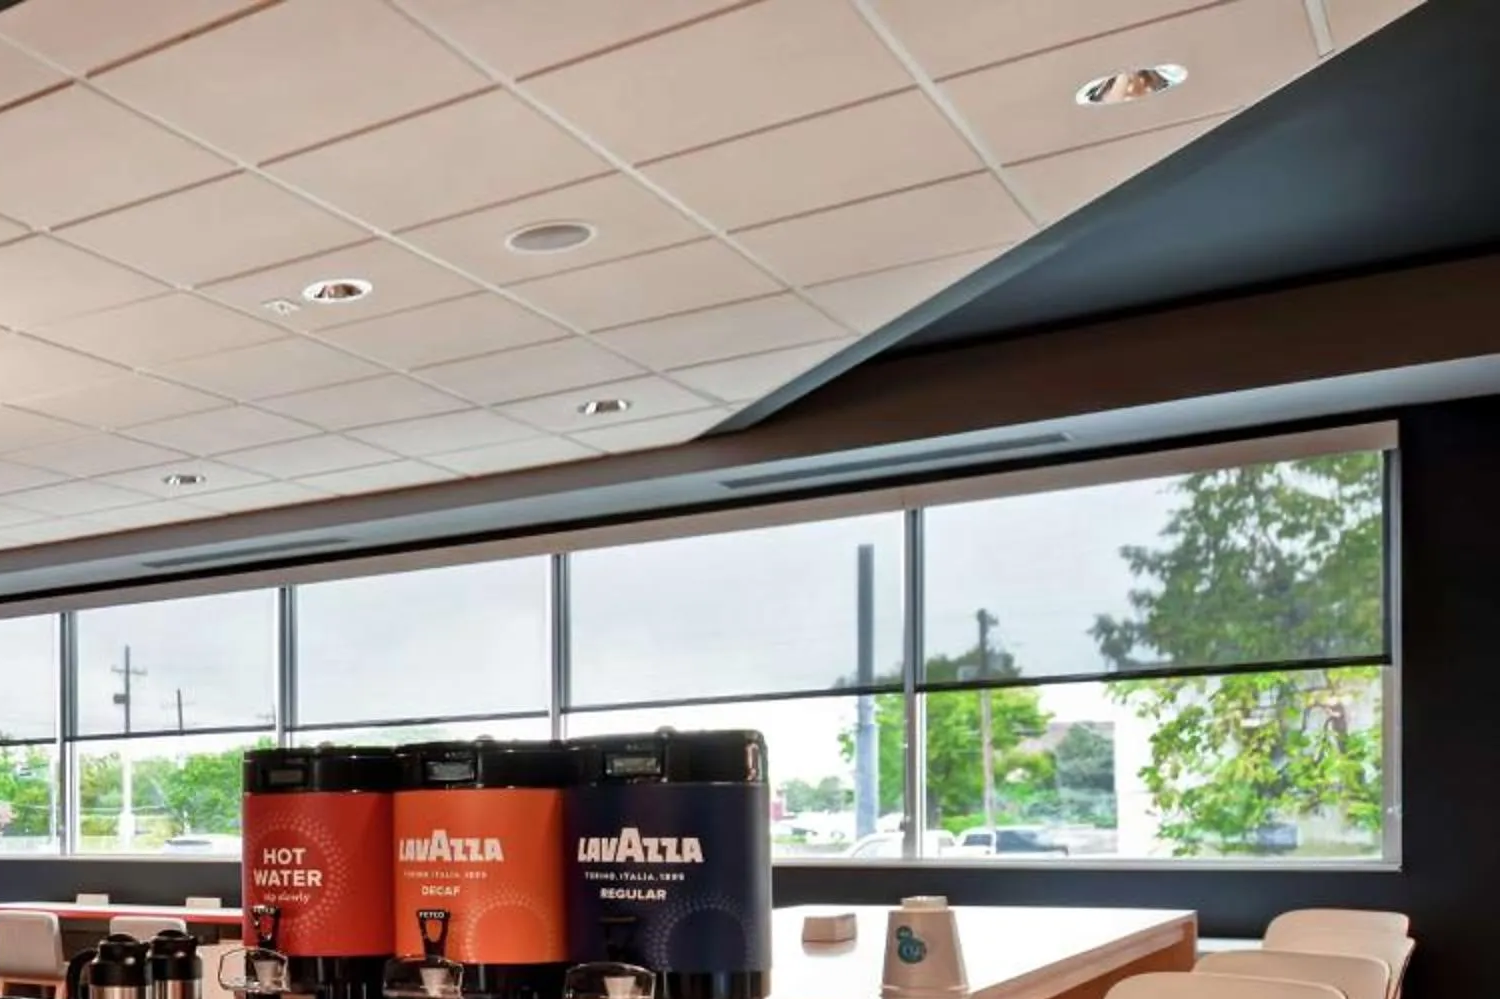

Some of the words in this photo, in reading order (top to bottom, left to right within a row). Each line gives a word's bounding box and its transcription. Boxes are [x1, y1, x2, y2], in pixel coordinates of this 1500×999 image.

[399, 829, 504, 862] LAVAZZA
[578, 827, 704, 863] LAVAZZA
[263, 847, 307, 865] HOT
[253, 868, 323, 887] WATER
[421, 885, 461, 896] DECAF
[600, 887, 667, 900] REGULAR
